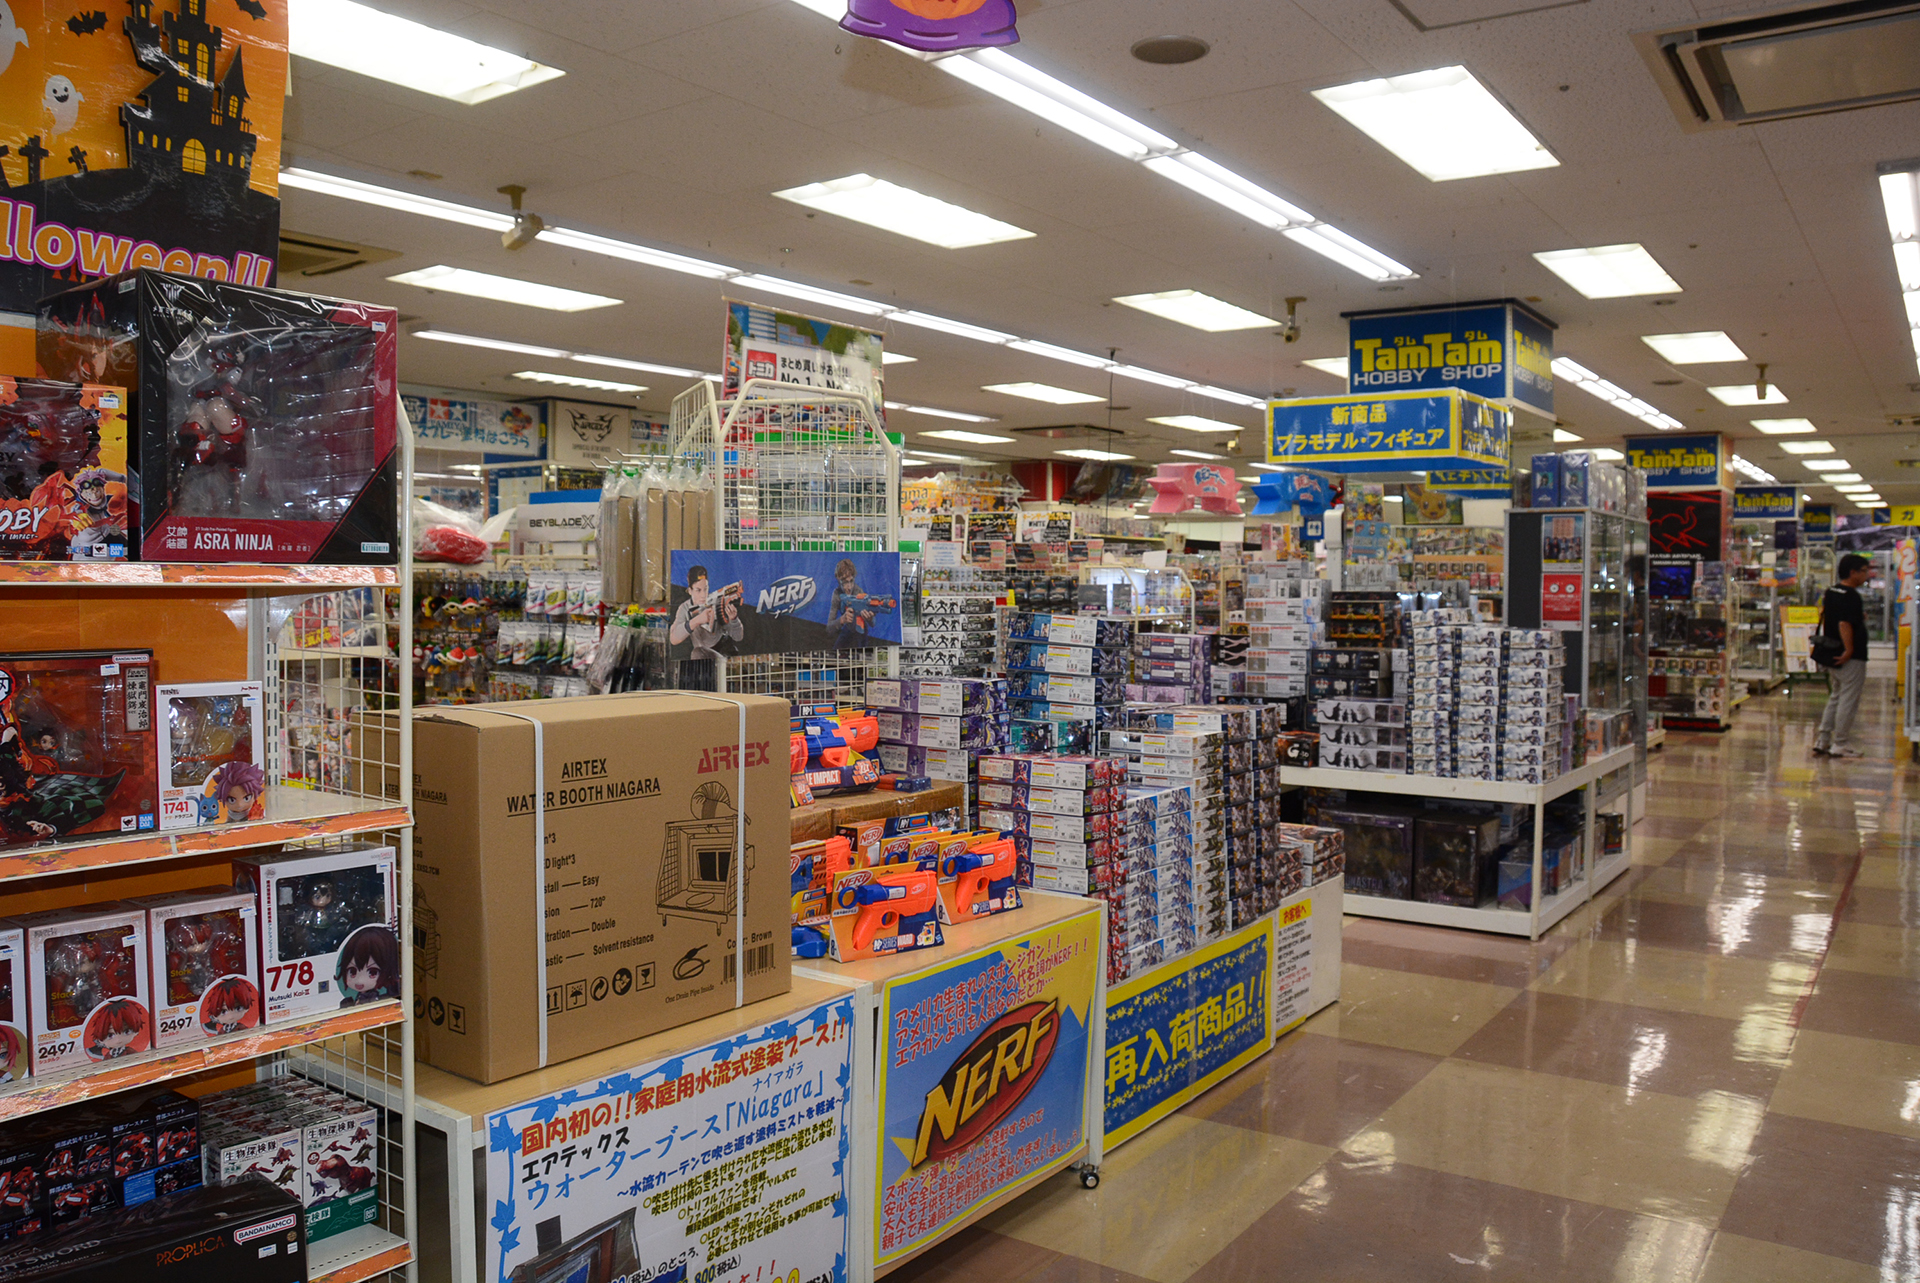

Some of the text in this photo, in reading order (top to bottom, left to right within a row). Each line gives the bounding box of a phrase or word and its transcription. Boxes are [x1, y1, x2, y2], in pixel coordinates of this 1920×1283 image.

[1354, 333, 1502, 372] TamTam
[1354, 364, 1502, 386] HOBBY SHOP
[1331, 403, 1387, 426] 新商品
[1277, 428, 1445, 452] プラモデル・フィギュア
[1629, 449, 1716, 468] TamTam
[529, 517, 582, 528] BEYBLADE
[194, 532, 274, 551] ASRA NINJA
[756, 577, 814, 614] NERF
[768, 603, 796, 620] ナーフ
[561, 758, 607, 779] AIRTEX
[813, 770, 839, 785] IMPACT
[559, 785, 603, 806] BOOTH
[606, 777, 661, 799] NIAGARA
[163, 801, 189, 814] 1741
[860, 827, 883, 844] NERF
[941, 841, 967, 861] NERF
[582, 875, 600, 887] Easy
[836, 870, 872, 892] NERF
[591, 918, 616, 932] Double
[593, 941, 619, 956] Solvent
[619, 933, 655, 950] resistance
[751, 930, 773, 944] Brown
[170, 968, 192, 978] Stark
[266, 960, 315, 993] 778
[51, 991, 75, 1001] Stark
[268, 993, 293, 1003] Mutsuki
[160, 1016, 193, 1033] 2497
[1105, 970, 1265, 1094] 再入荷商品!!
[38, 1041, 76, 1060] 2497
[753, 1061, 804, 1093] ナイアガラ
[911, 998, 1060, 1171] NERF
[307, 1120, 356, 1140] 生物探検隊
[224, 1140, 278, 1162] 生物探検隊
[521, 1126, 631, 1184] エアテックス
[238, 1218, 293, 1239] BANDAI NAMCO
[25, 1240, 101, 1265] SWORD
[157, 1235, 226, 1267] PROPLICA
